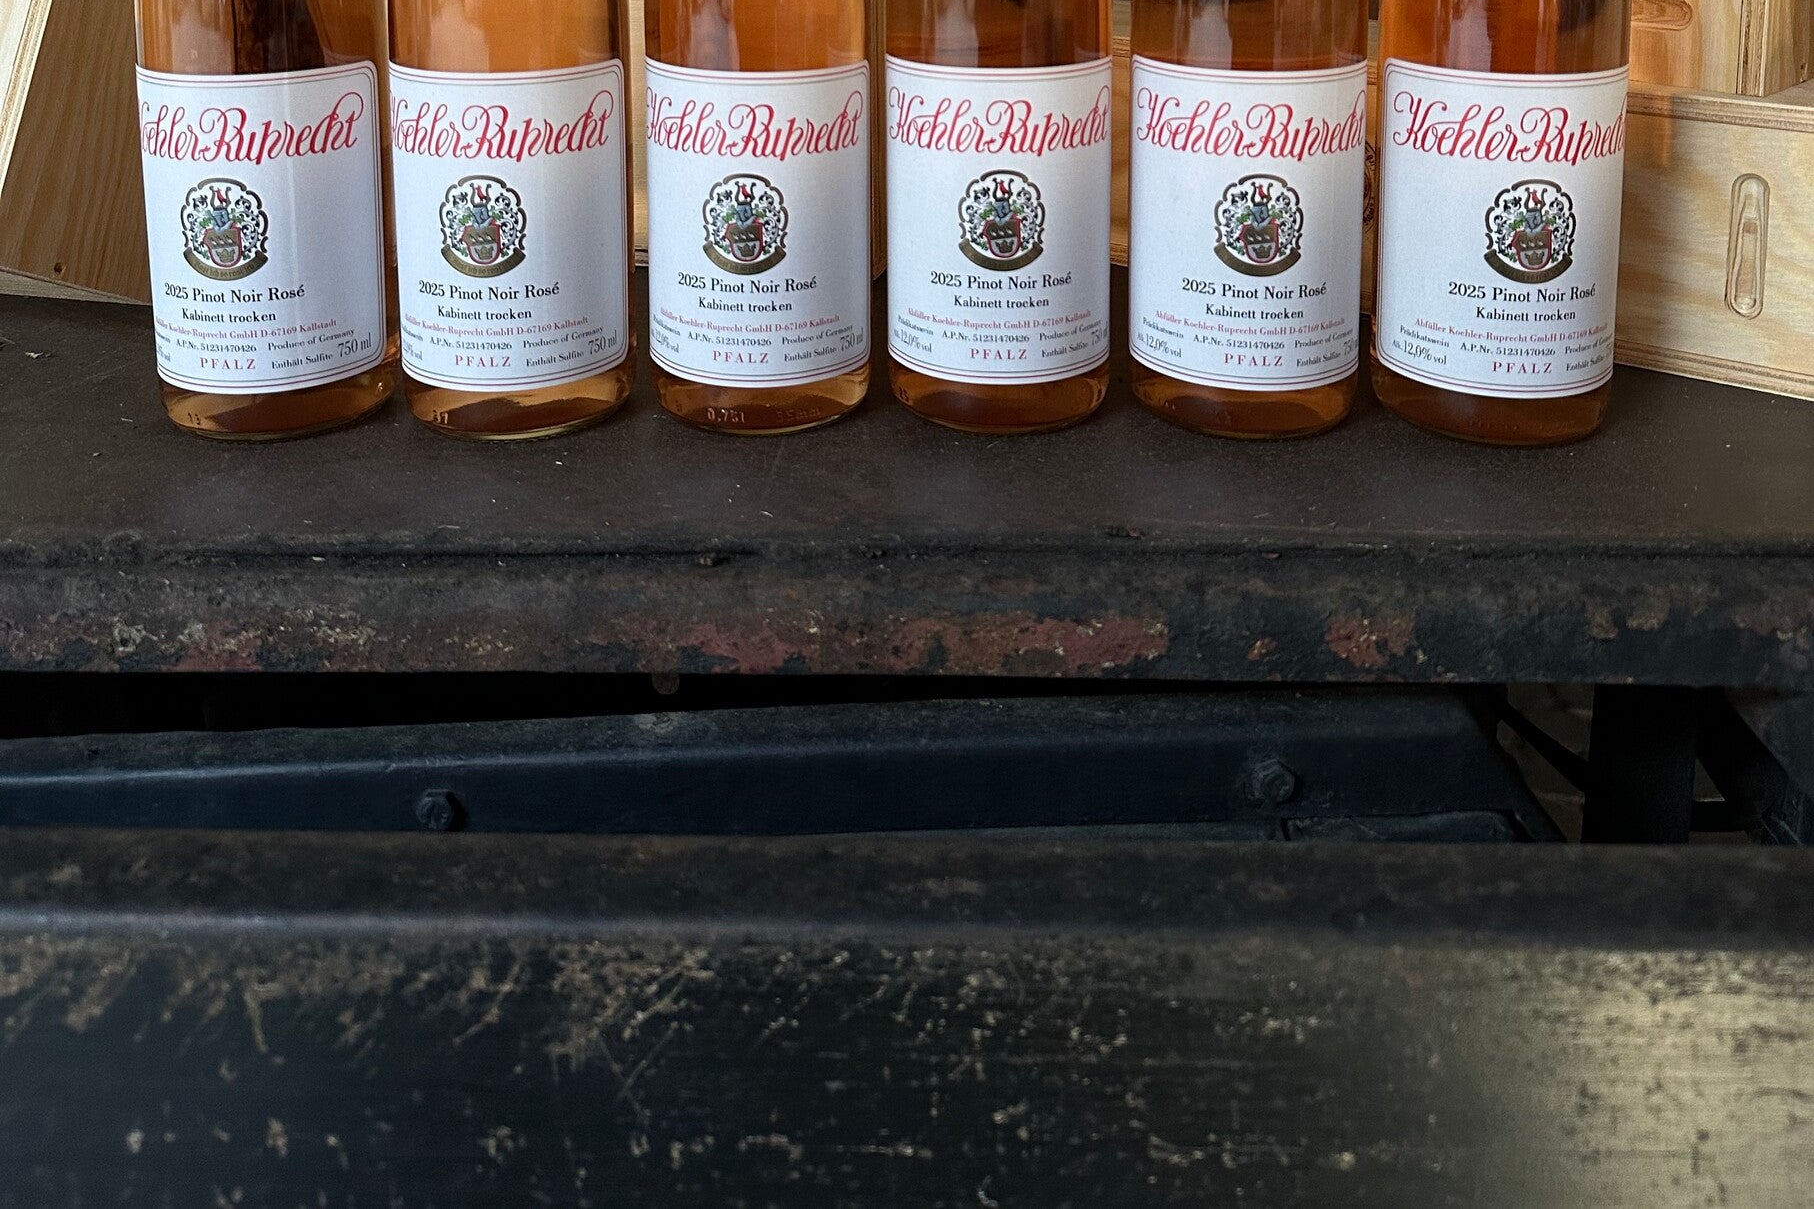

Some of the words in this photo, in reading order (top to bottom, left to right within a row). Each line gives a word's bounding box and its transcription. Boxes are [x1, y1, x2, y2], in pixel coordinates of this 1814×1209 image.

[678, 272, 706, 289] 2025
[711, 277, 744, 293] Pinot
[750, 280, 780, 293] Noir
[785, 276, 816, 292] Rosé
[931, 271, 962, 287] 2025
[968, 276, 1002, 290] Pinot
[1008, 276, 1037, 289] Noir
[1043, 271, 1072, 287] Rosé
[165, 283, 189, 300] 2025
[193, 287, 225, 303] Pinot
[231, 289, 263, 303] Noir
[268, 284, 305, 301] Rosé
[419, 280, 445, 297] 2025
[449, 285, 482, 300] Pinot
[488, 287, 519, 300] Noir
[525, 282, 560, 298] Rosé
[1182, 278, 1216, 295] 2025
[1222, 283, 1258, 299] Pinot
[1264, 286, 1294, 299] Noir
[1299, 282, 1327, 298] Rosé
[1448, 281, 1486, 299] 2025
[1492, 287, 1530, 302] Pinot
[1537, 289, 1566, 302] Noir
[1570, 283, 1596, 300] Rosé
[699, 297, 744, 312] Kabinett
[749, 301, 792, 312] trocken
[954, 295, 1002, 309] Kabinett
[1007, 297, 1049, 308] trocken
[182, 308, 224, 323] Kabinett
[229, 312, 276, 322] trocken
[438, 305, 481, 320] Kabinett
[486, 309, 532, 320] trocken
[1206, 304, 1256, 319] Kabinett
[1261, 309, 1304, 319] trocken
[1476, 307, 1529, 321] Kabinett
[1534, 310, 1576, 321] trocken
[486, 327, 513, 336] GmbH
[745, 324, 772, 332] GmbH
[1004, 320, 1030, 329] GmbH
[1259, 327, 1287, 335] GmbH
[230, 330, 258, 339] GmbH
[1530, 333, 1556, 342] GmbH
[1434, 355, 1447, 365] vol
